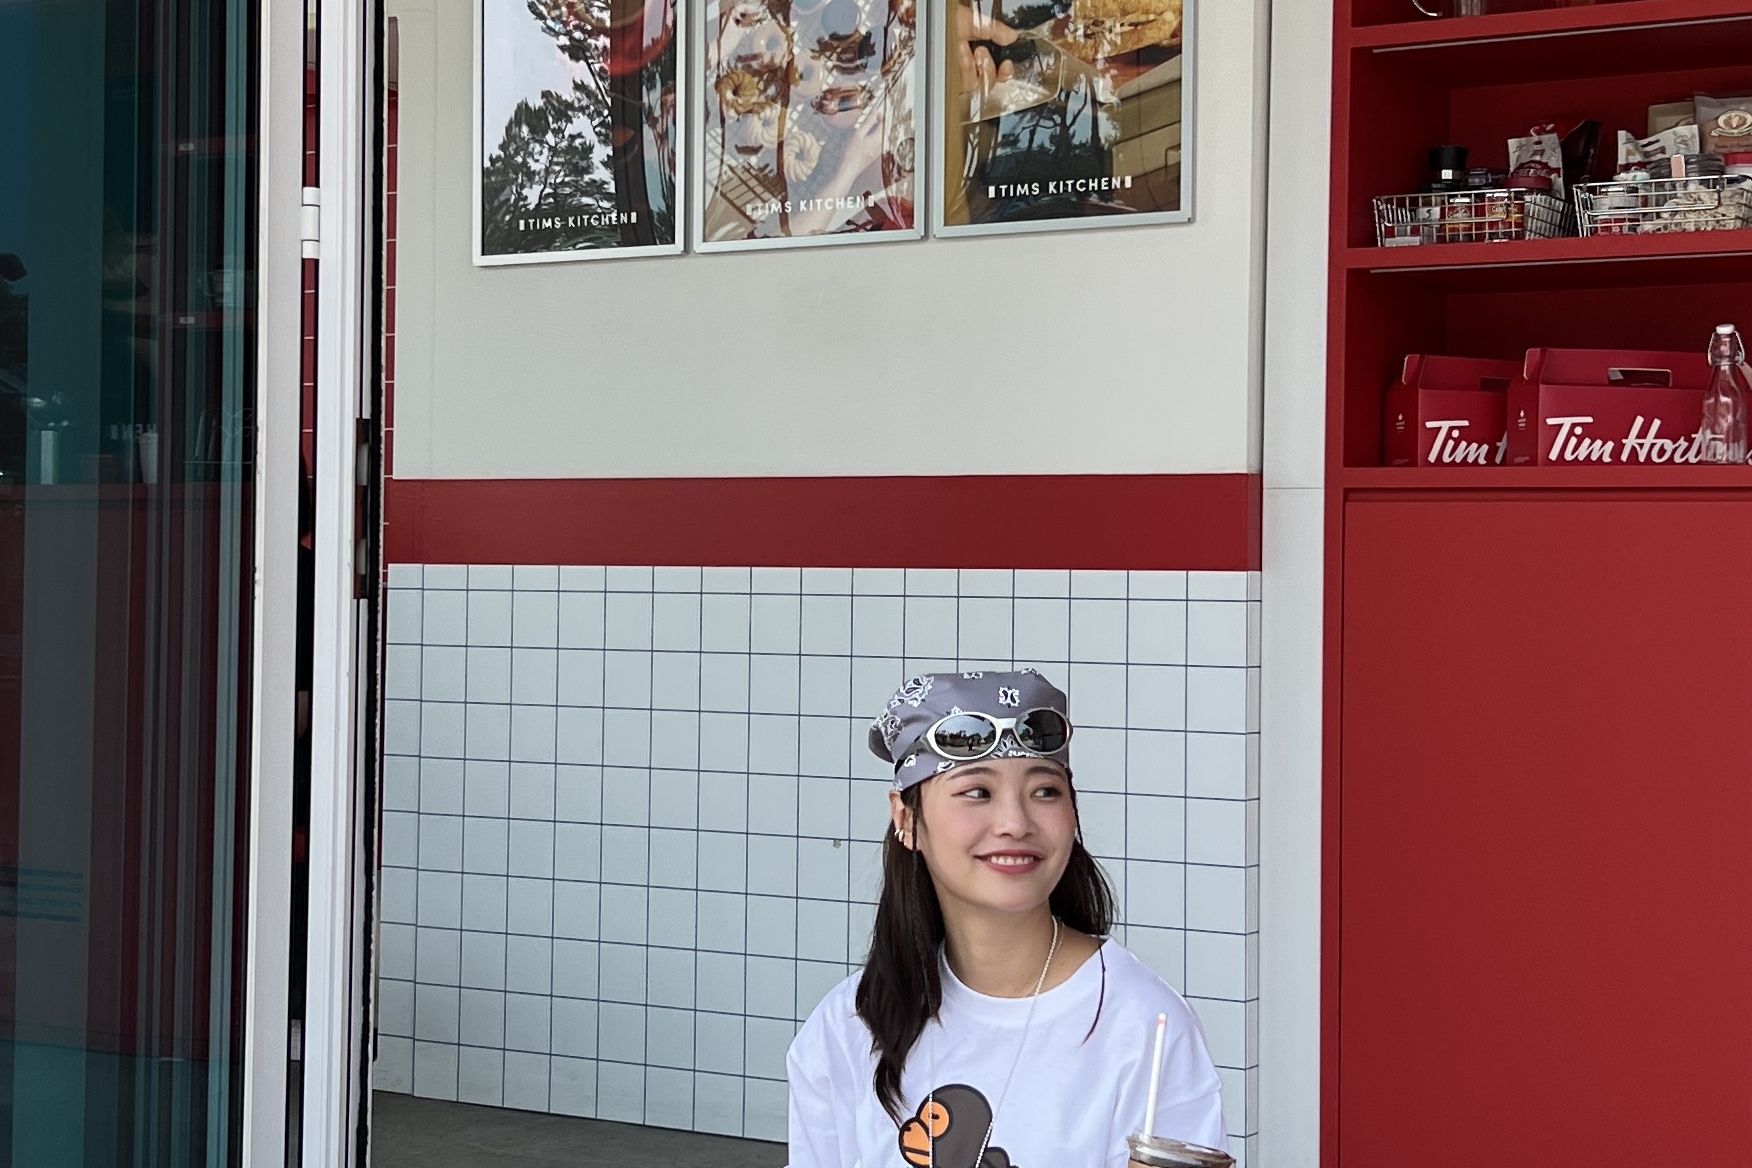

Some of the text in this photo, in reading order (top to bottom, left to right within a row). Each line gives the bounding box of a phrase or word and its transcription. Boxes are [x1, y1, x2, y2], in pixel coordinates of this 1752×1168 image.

[999, 176, 1121, 198] TIMS KITCHEN
[755, 195, 865, 214] TIMS KITCHEN
[528, 211, 628, 230] TIMS KITCHEN
[1425, 420, 1489, 464] Tim
[1545, 416, 1614, 463] Tim
[1622, 415, 1752, 465] Hort
